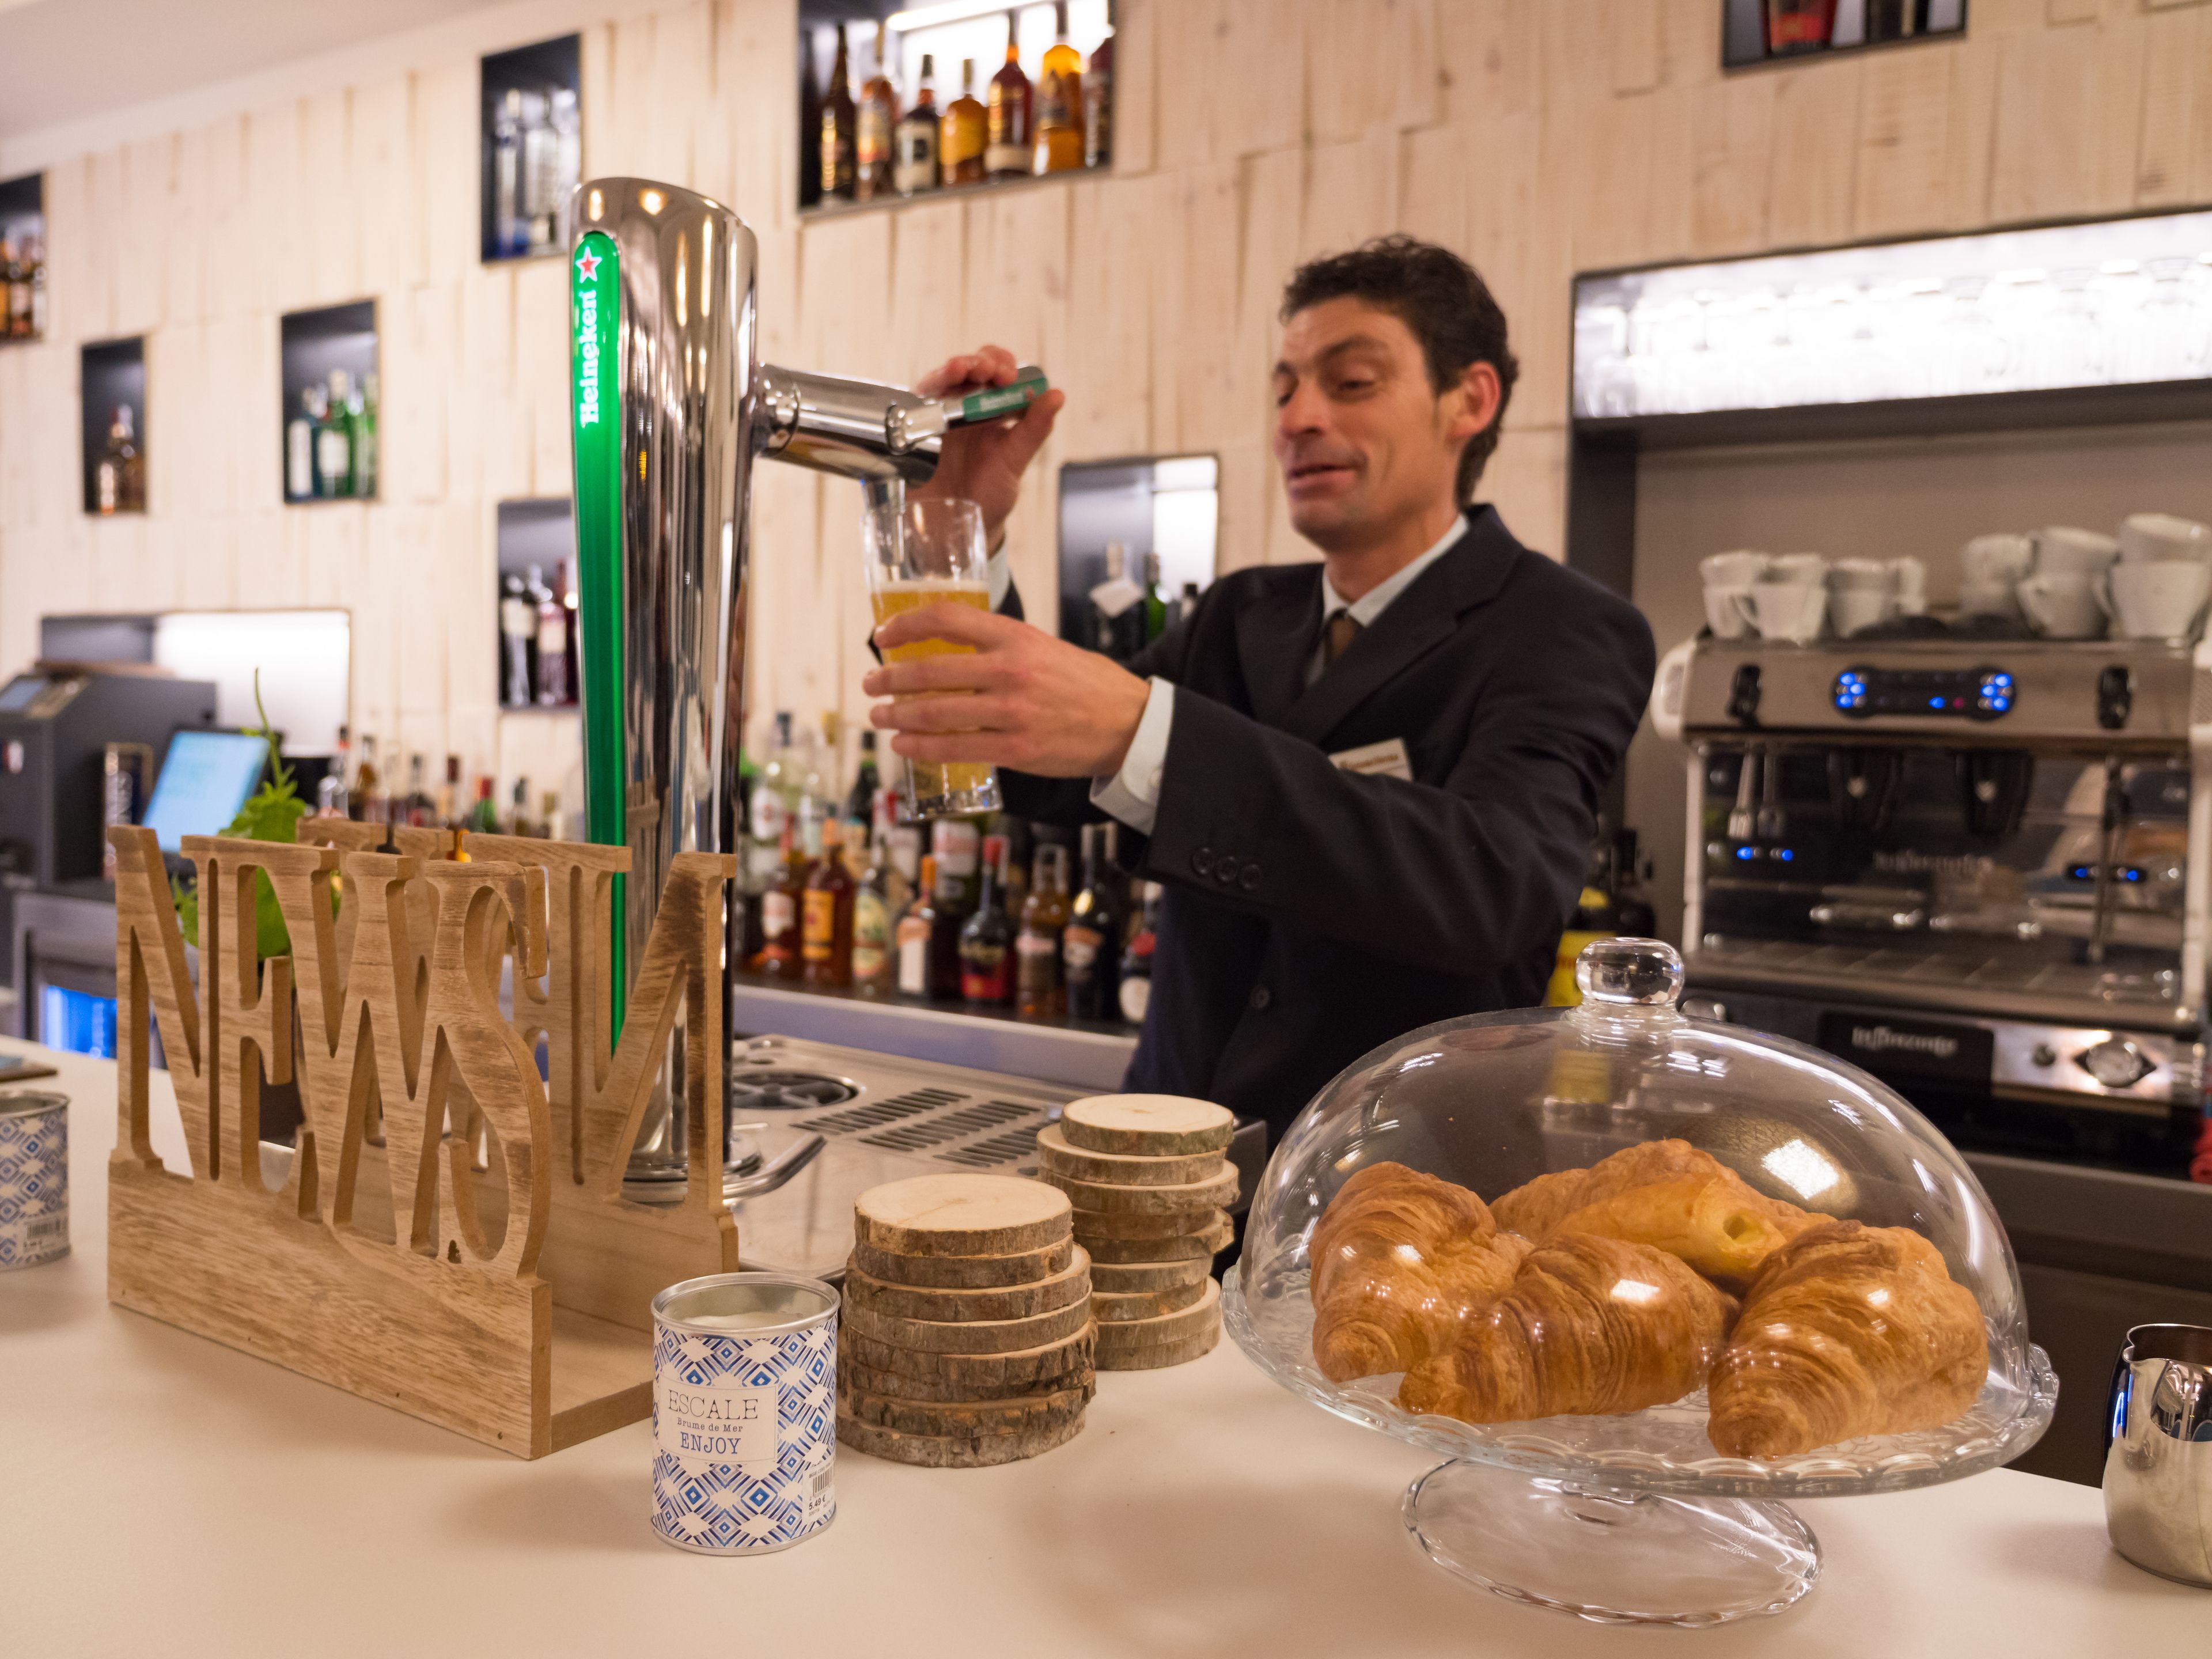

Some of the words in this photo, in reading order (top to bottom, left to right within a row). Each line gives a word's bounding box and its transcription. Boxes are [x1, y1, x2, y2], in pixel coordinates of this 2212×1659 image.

[579, 289, 600, 425] Heineken
[108, 825, 550, 1280] NEWS
[668, 1389, 758, 1420] ESCALE
[677, 1417, 705, 1430] Brume
[709, 1423, 719, 1431] de
[723, 1424, 743, 1432] Mer
[680, 1431, 741, 1455] ENJOY
